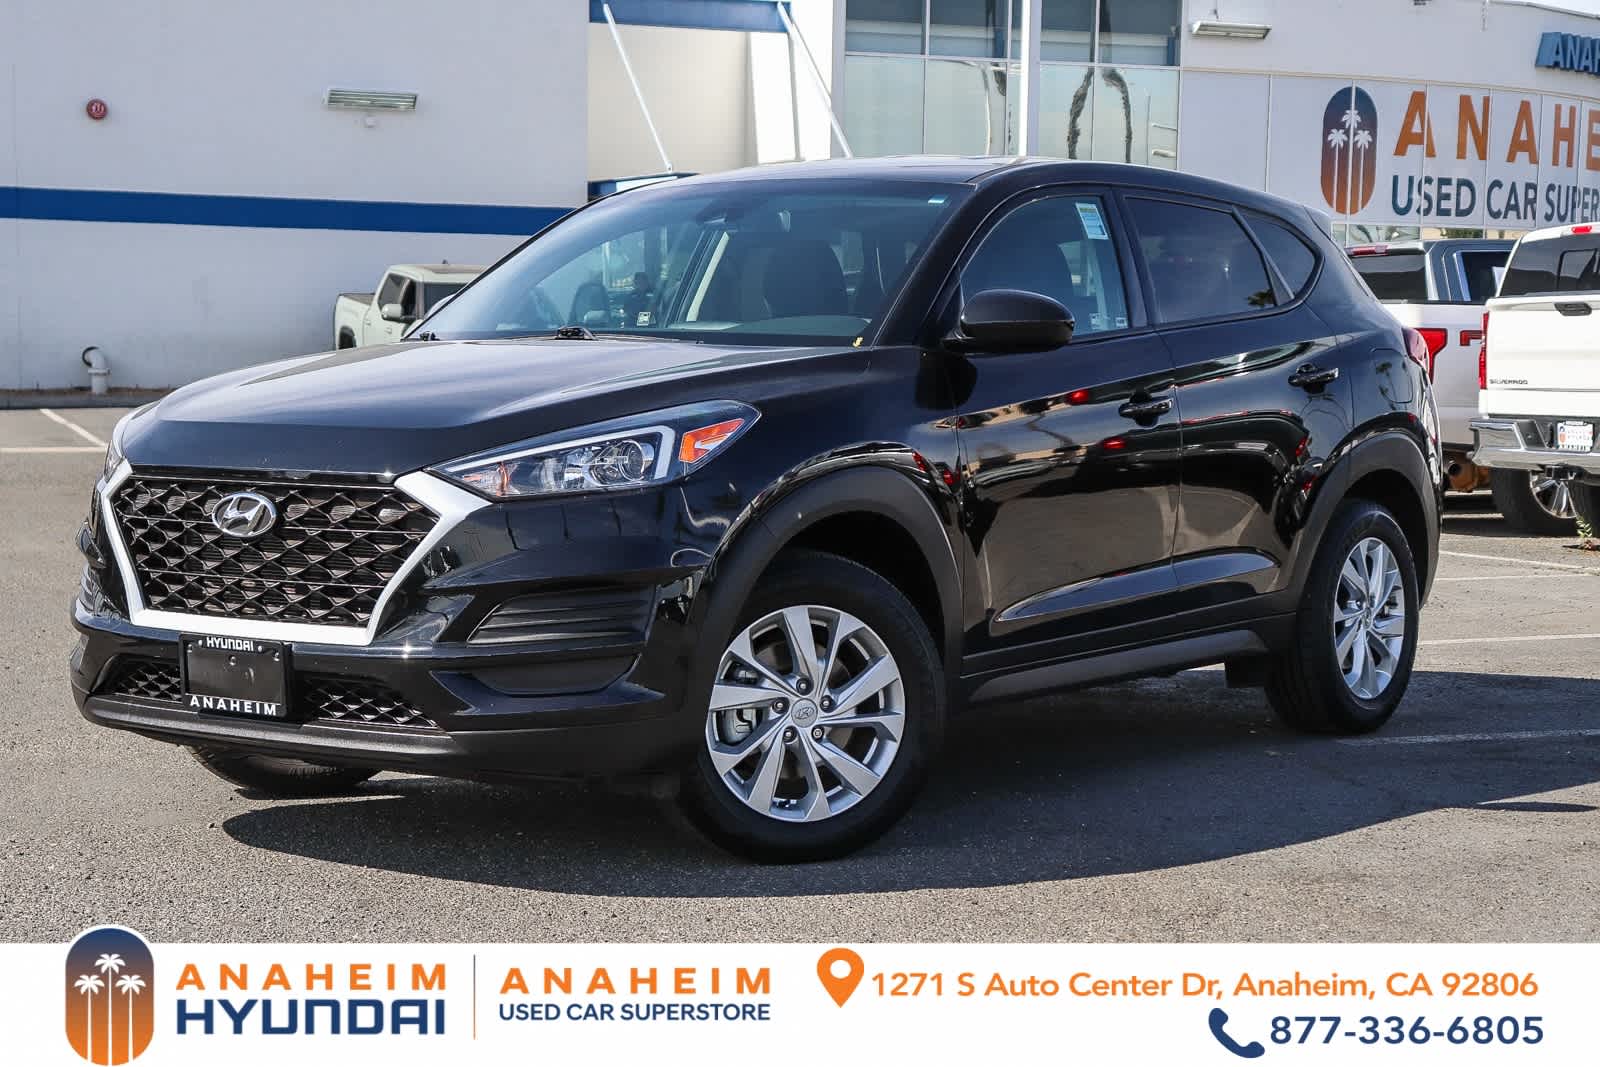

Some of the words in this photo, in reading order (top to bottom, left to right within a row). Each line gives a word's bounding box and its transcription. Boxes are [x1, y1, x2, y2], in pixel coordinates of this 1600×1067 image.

[1393, 91, 1600, 171] ANAHE
[1391, 175, 1476, 217] USED
[1486, 180, 1537, 220] CAR
[1544, 183, 1600, 223] SUPER
[206, 636, 254, 652] HYUNDAI
[190, 695, 277, 716] ANAHEIM
